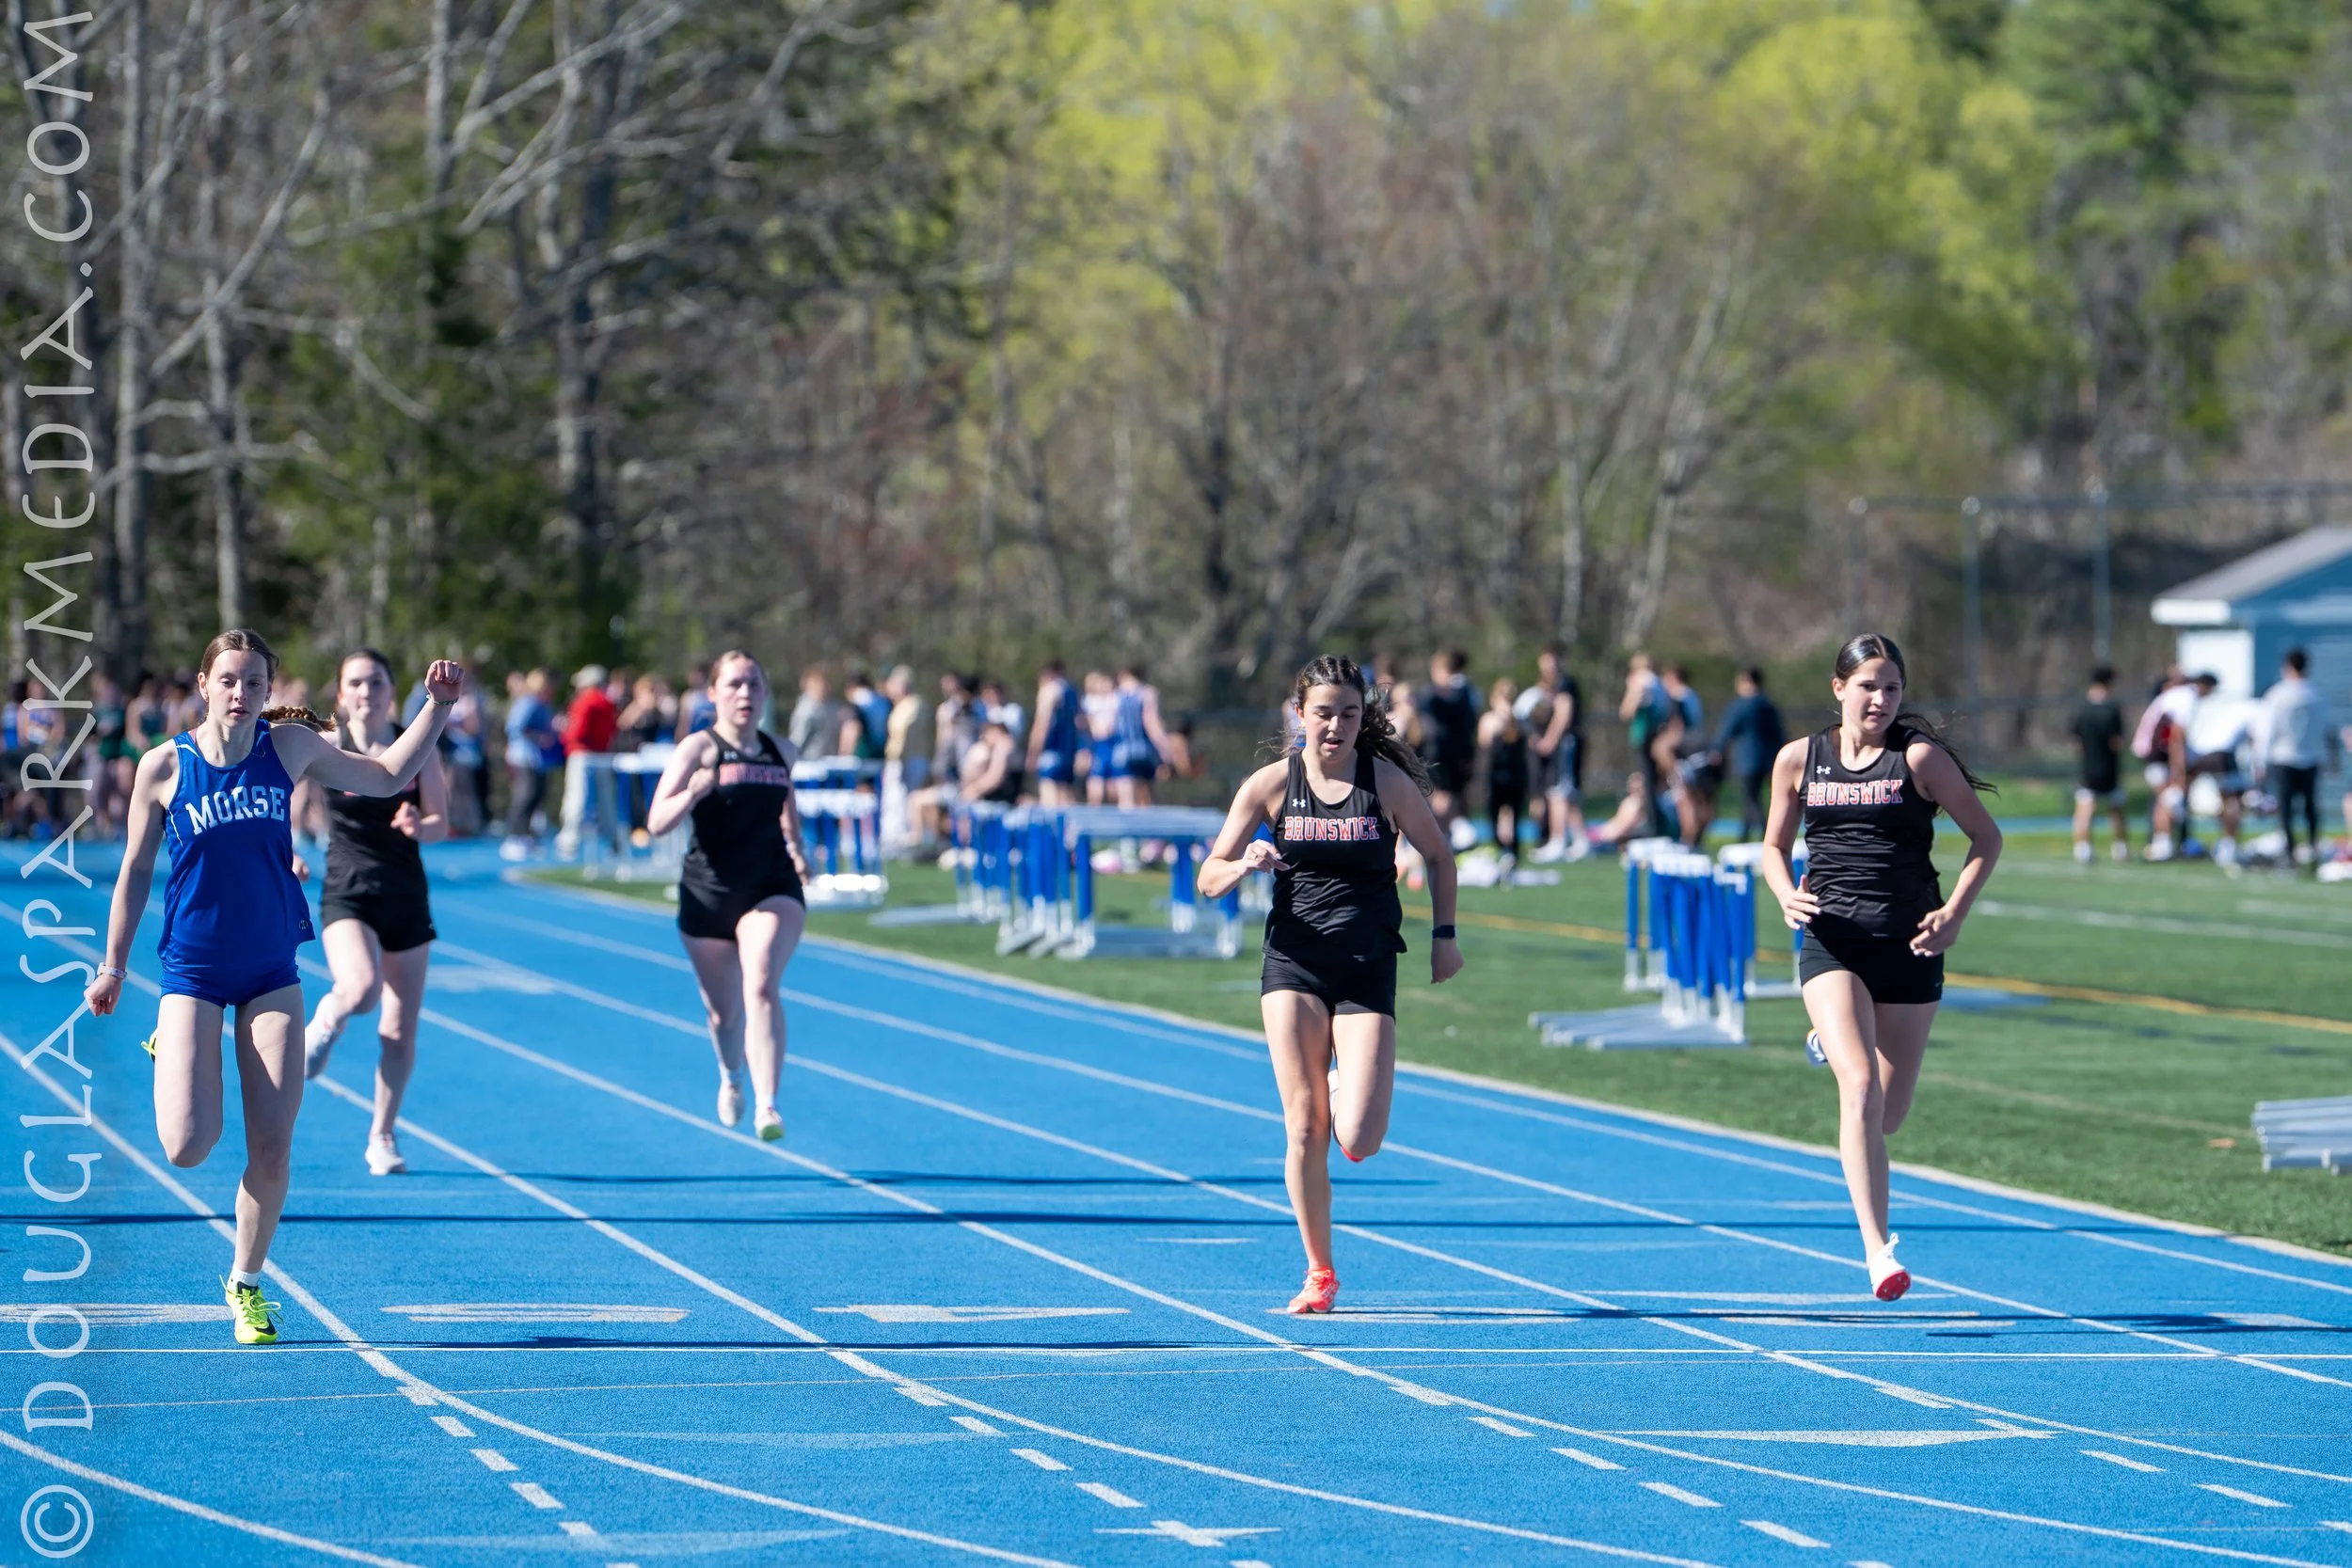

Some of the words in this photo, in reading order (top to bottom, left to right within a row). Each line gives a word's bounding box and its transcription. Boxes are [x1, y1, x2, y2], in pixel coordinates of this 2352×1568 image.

[1806, 779, 1903, 807] BRUNSWICK
[185, 785, 285, 835] MORSE
[1284, 816, 1380, 842] BRUNSWICK
